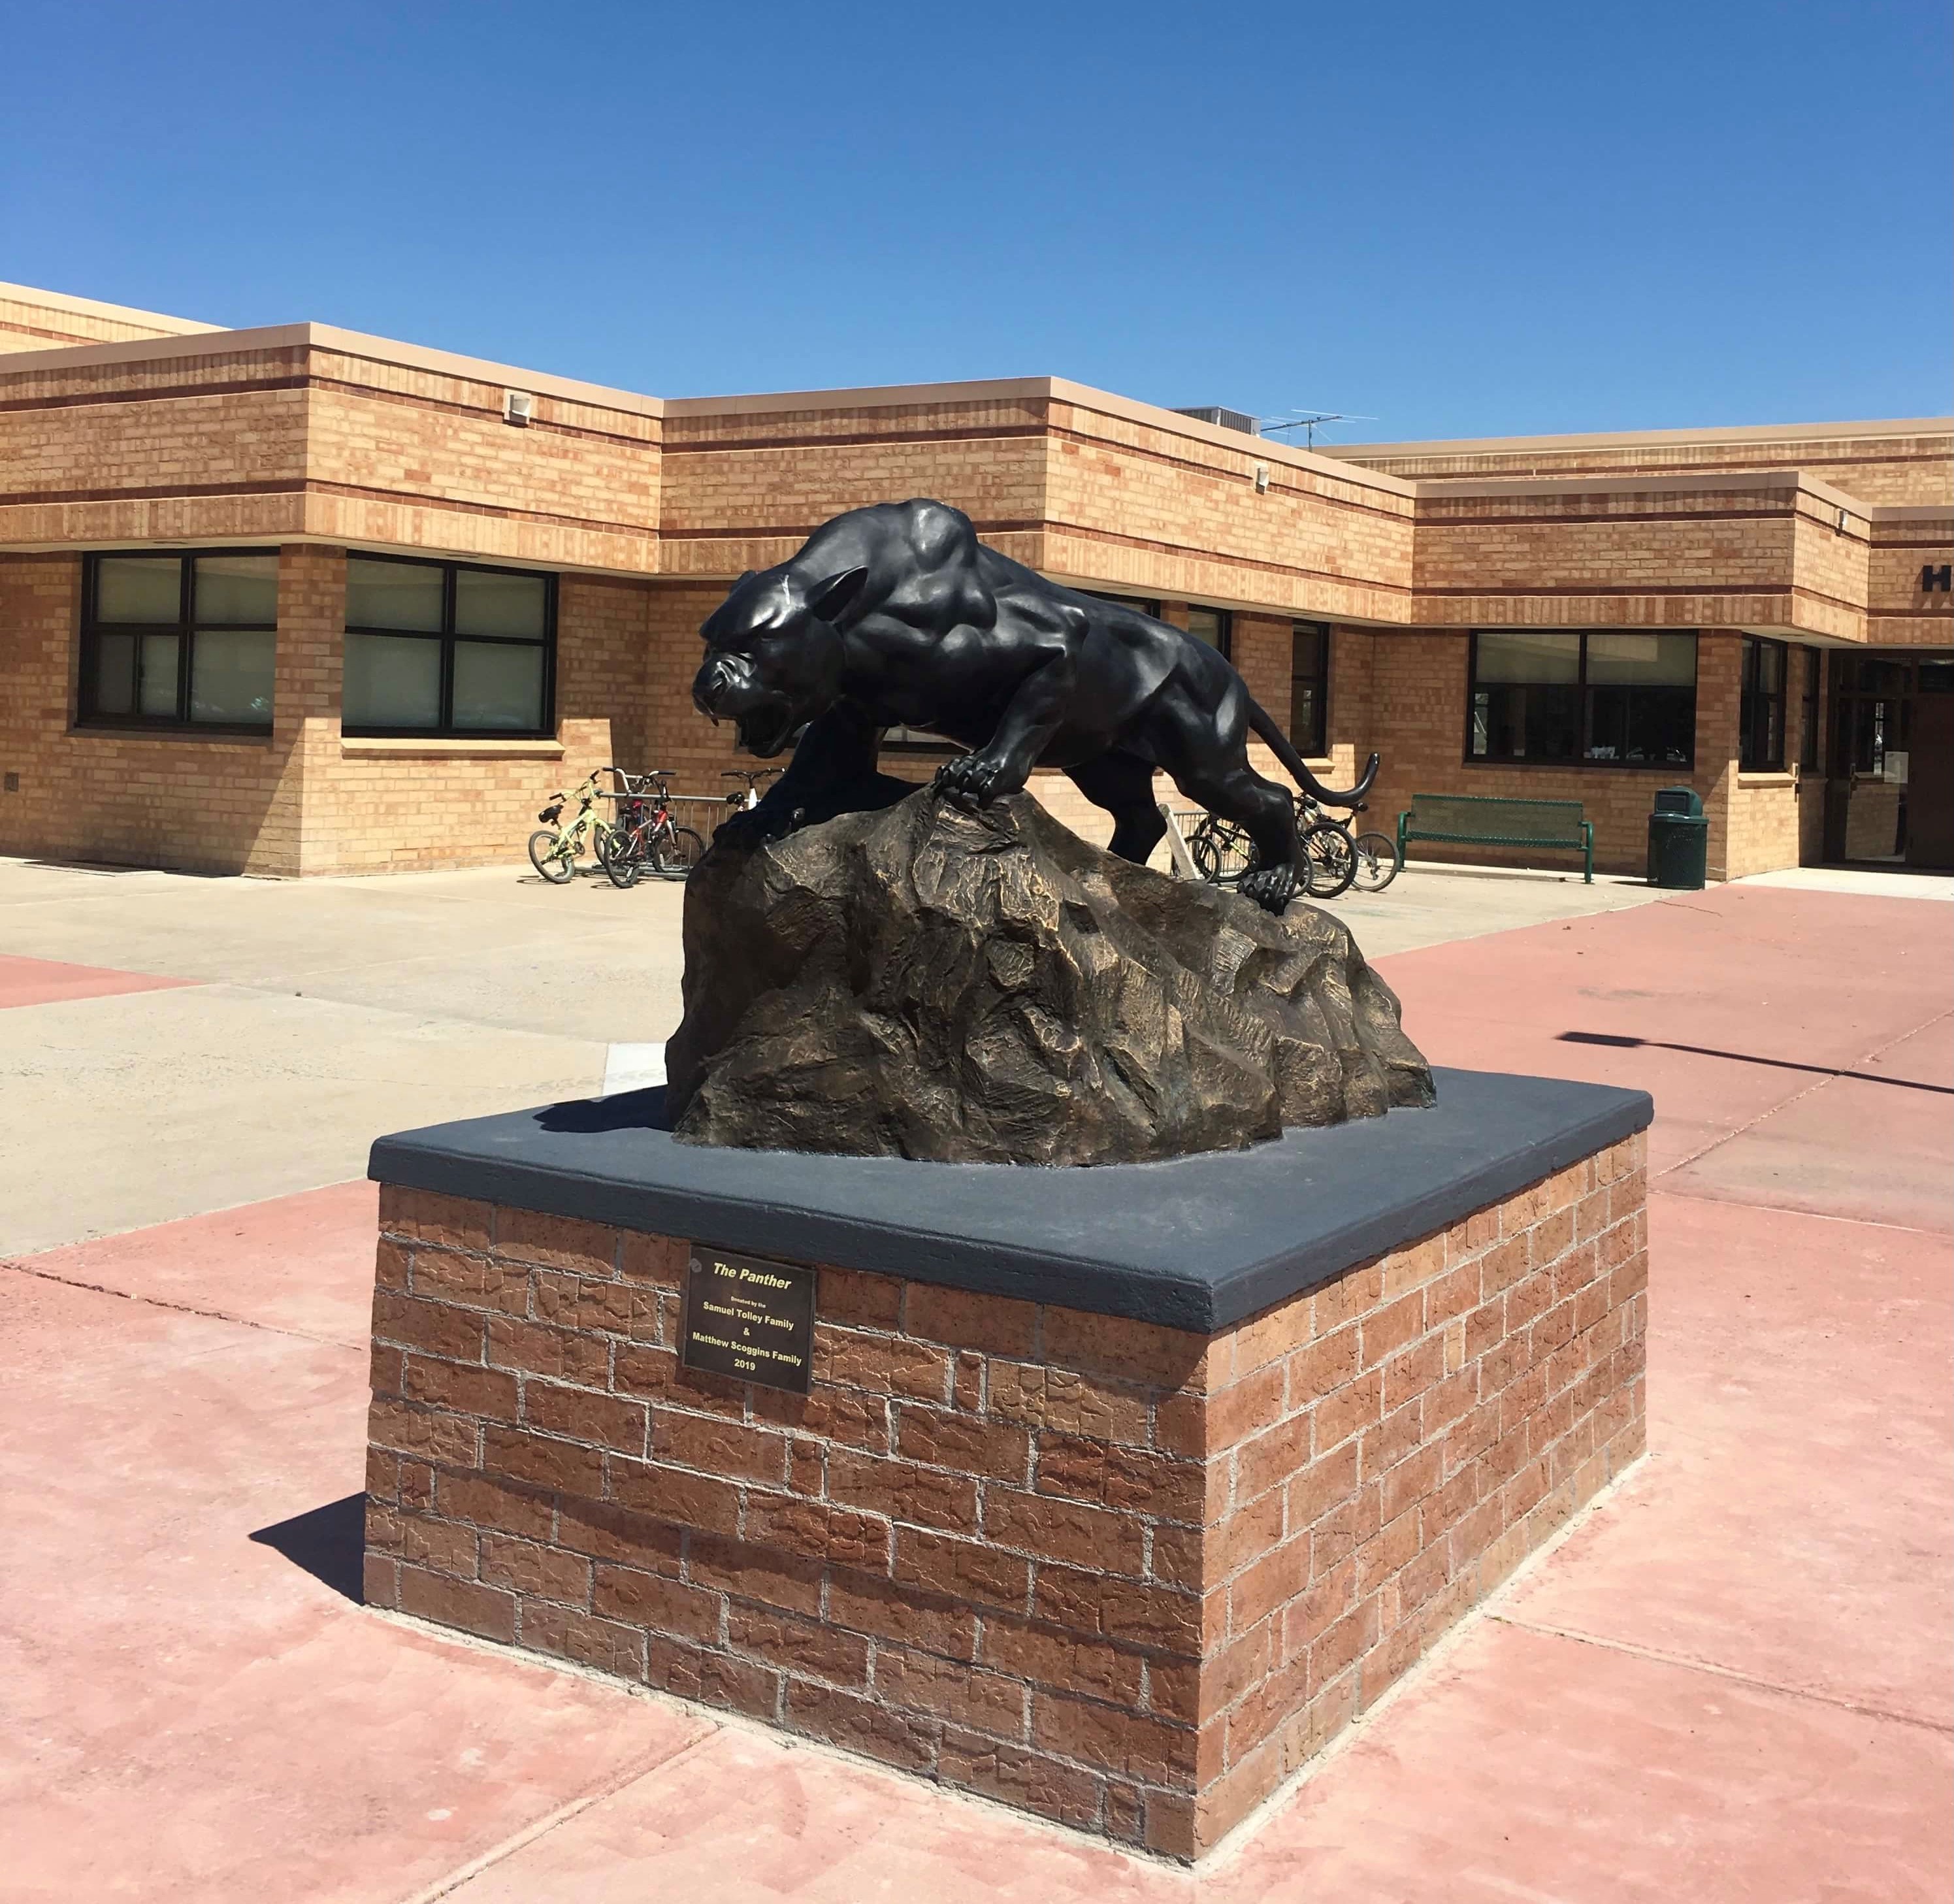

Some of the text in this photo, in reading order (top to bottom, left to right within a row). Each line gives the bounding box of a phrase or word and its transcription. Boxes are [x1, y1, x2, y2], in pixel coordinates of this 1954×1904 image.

[713, 1262, 792, 1289] The Panther
[703, 1301, 794, 1331] Samuel Tolley Family
[743, 1327, 751, 1336] &
[692, 1332, 802, 1367] Matthew Scoggins Family
[734, 1358, 756, 1371] 2019
